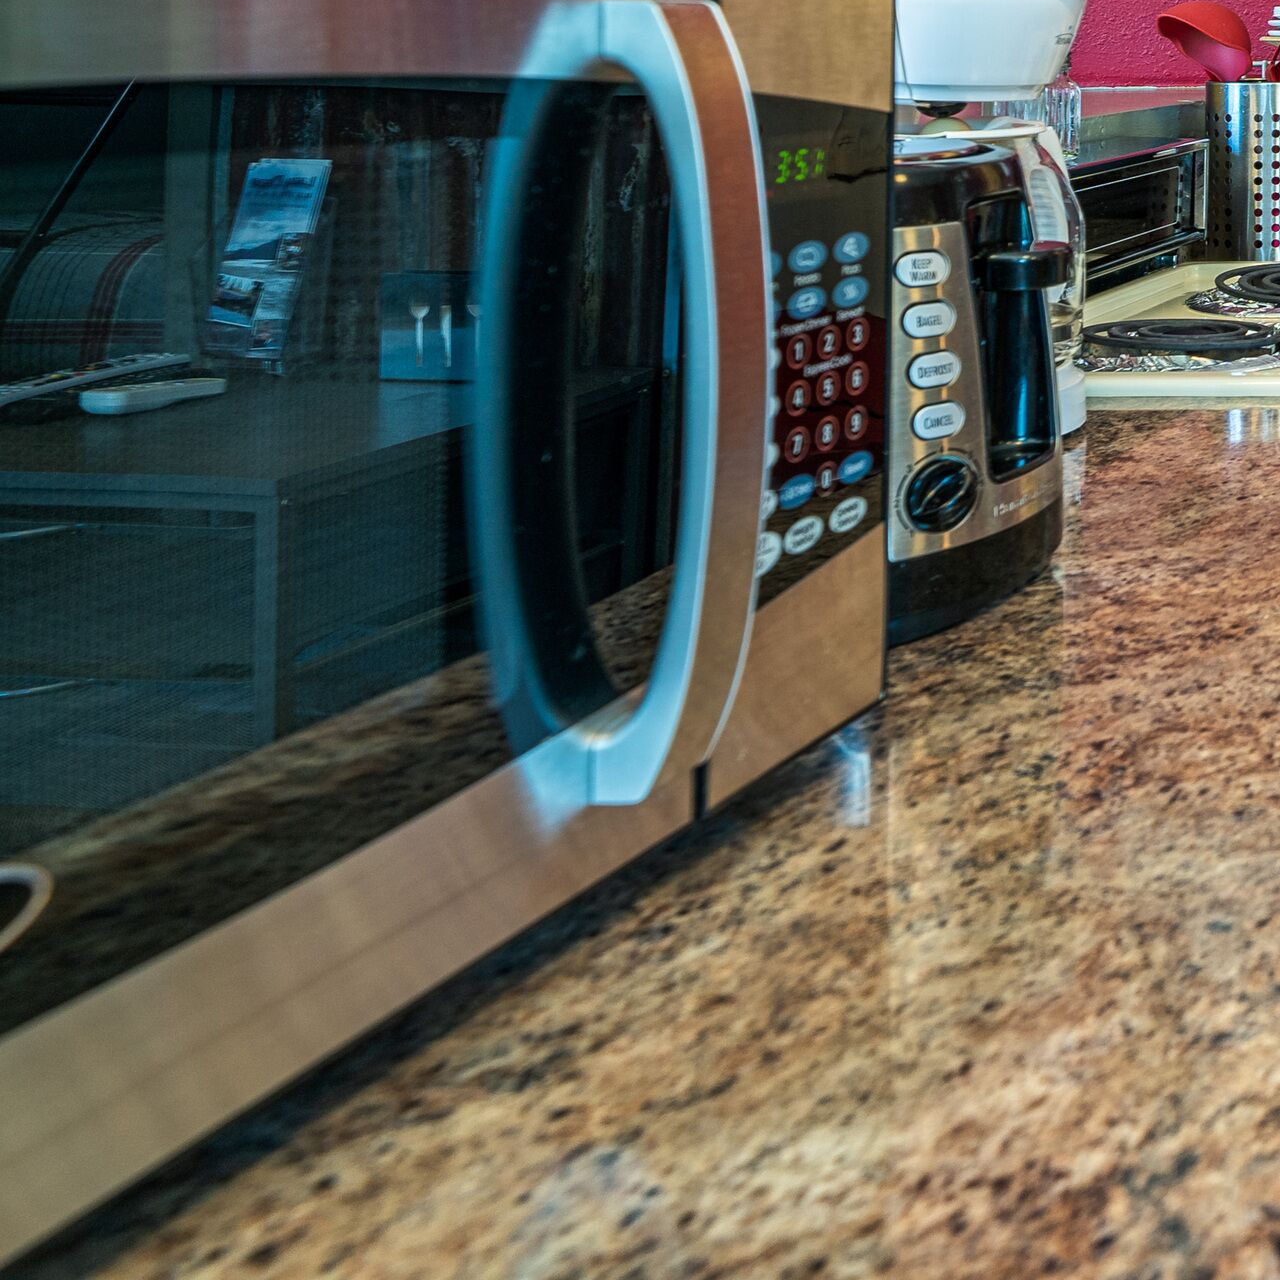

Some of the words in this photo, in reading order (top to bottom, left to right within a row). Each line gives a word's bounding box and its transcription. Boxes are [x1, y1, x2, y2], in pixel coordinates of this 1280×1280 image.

[911, 258, 933, 269] KEEP
[909, 270, 937, 282] WARM
[794, 341, 804, 361] 1
[824, 331, 835, 353] 2
[852, 323, 864, 344] 3
[917, 362, 954, 379] DEFROST
[793, 387, 804, 407] 4
[823, 377, 834, 398] 5
[852, 368, 863, 389] 6
[923, 414, 954, 430] CANCEL
[792, 434, 803, 455] 7
[822, 423, 833, 443] 8
[851, 412, 862, 433] 9
[822, 469, 833, 489] 0
